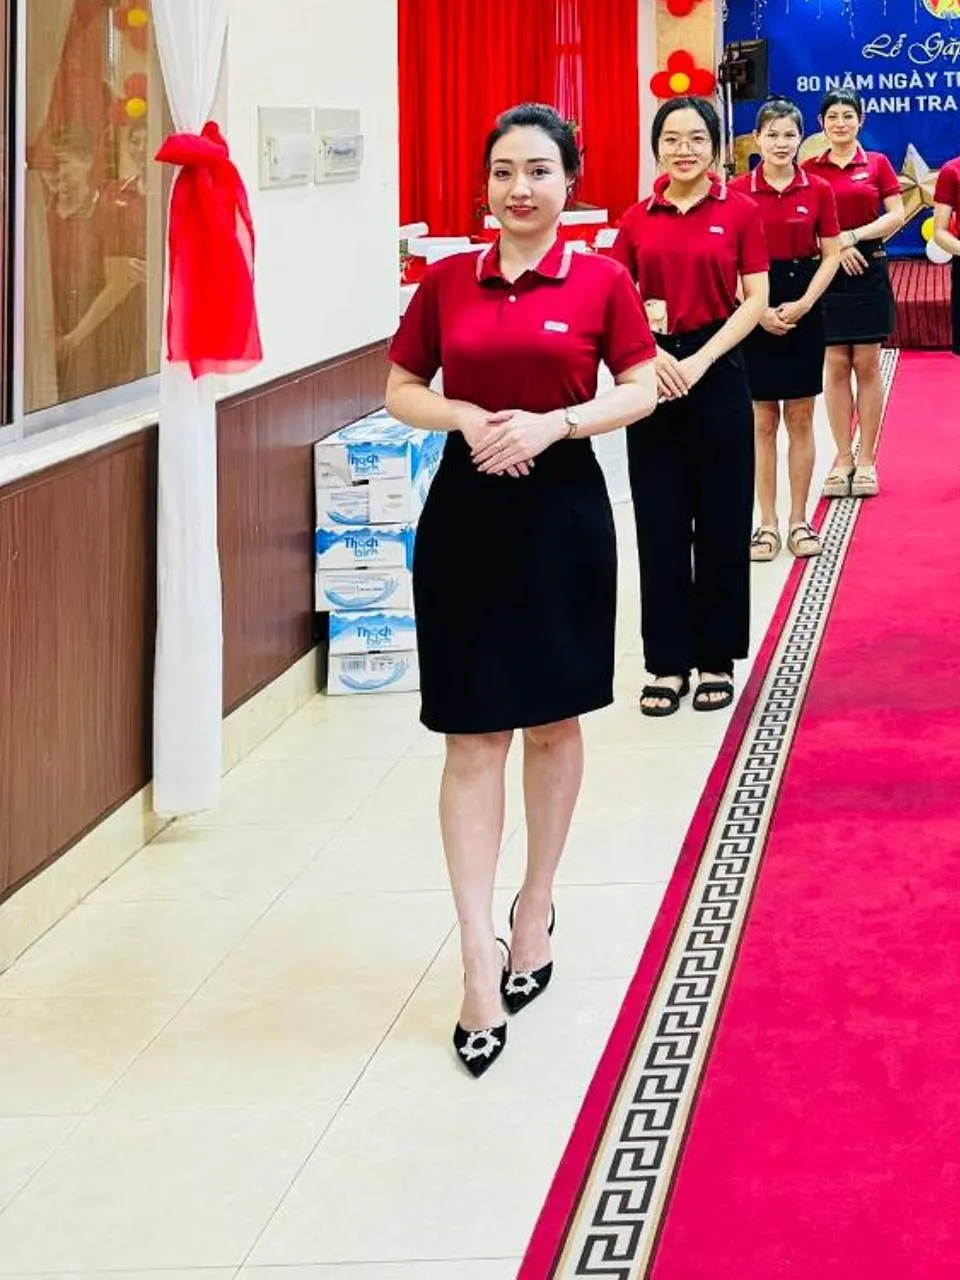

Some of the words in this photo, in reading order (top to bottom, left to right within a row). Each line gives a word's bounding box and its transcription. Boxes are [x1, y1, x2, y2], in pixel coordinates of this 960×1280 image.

[796, 76, 821, 92] 80
[825, 71, 873, 91] NĂM
[879, 70, 938, 90] NGÀY
[860, 97, 910, 113] ANH
[915, 95, 958, 112] TRA
